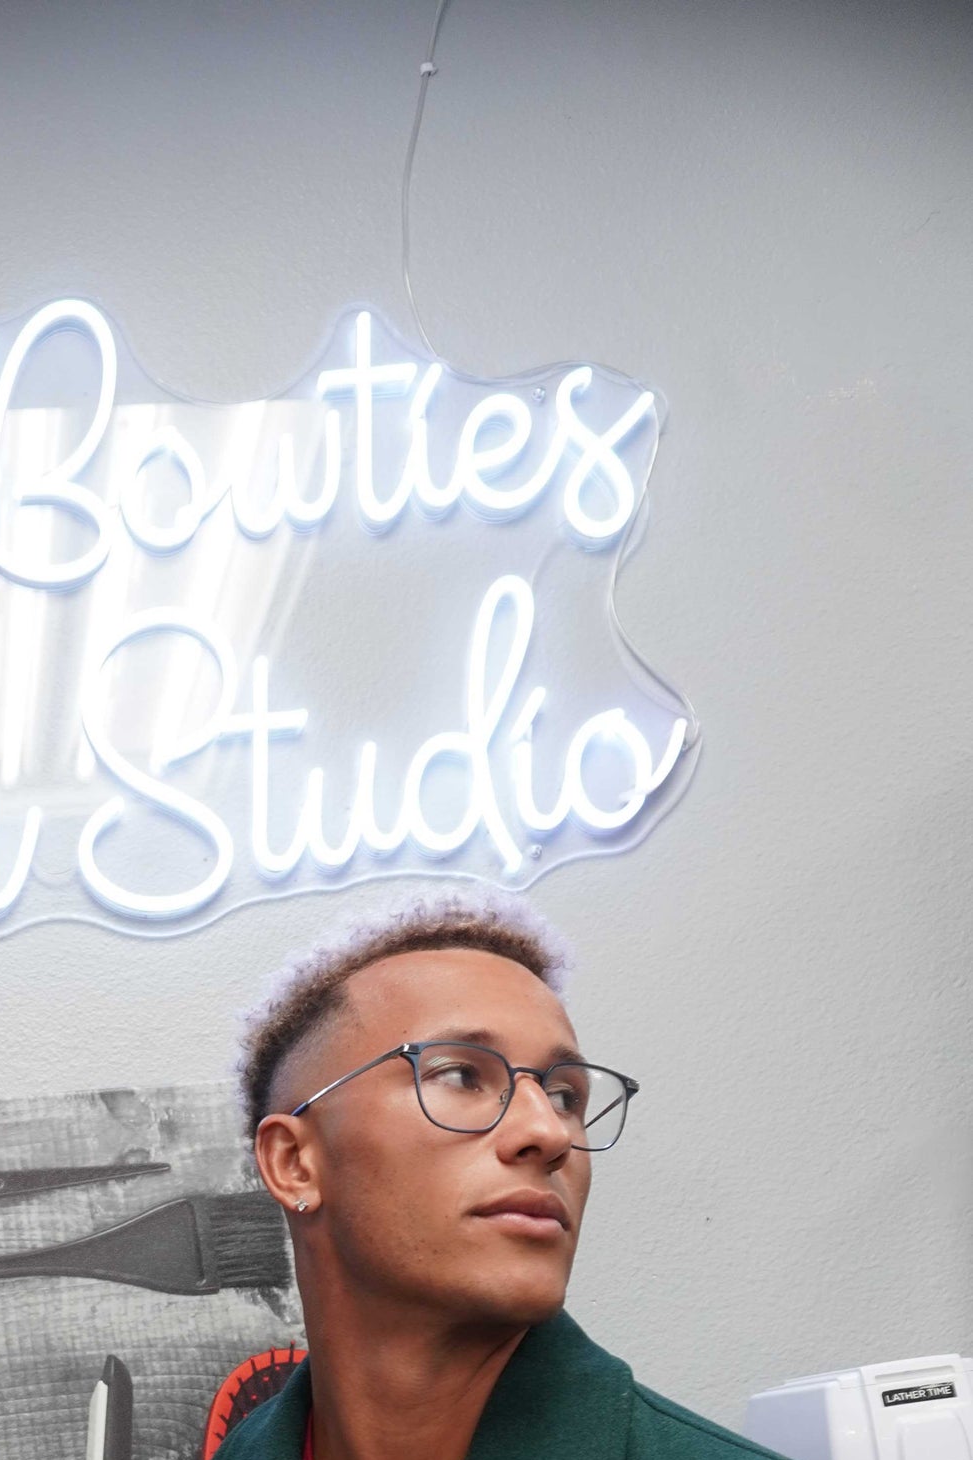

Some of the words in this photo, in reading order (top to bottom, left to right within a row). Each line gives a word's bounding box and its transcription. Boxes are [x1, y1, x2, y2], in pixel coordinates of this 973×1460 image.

[78, 573, 689, 914] Studio
[886, 1391, 925, 1403] LATHER
[927, 1386, 952, 1397] TIME
